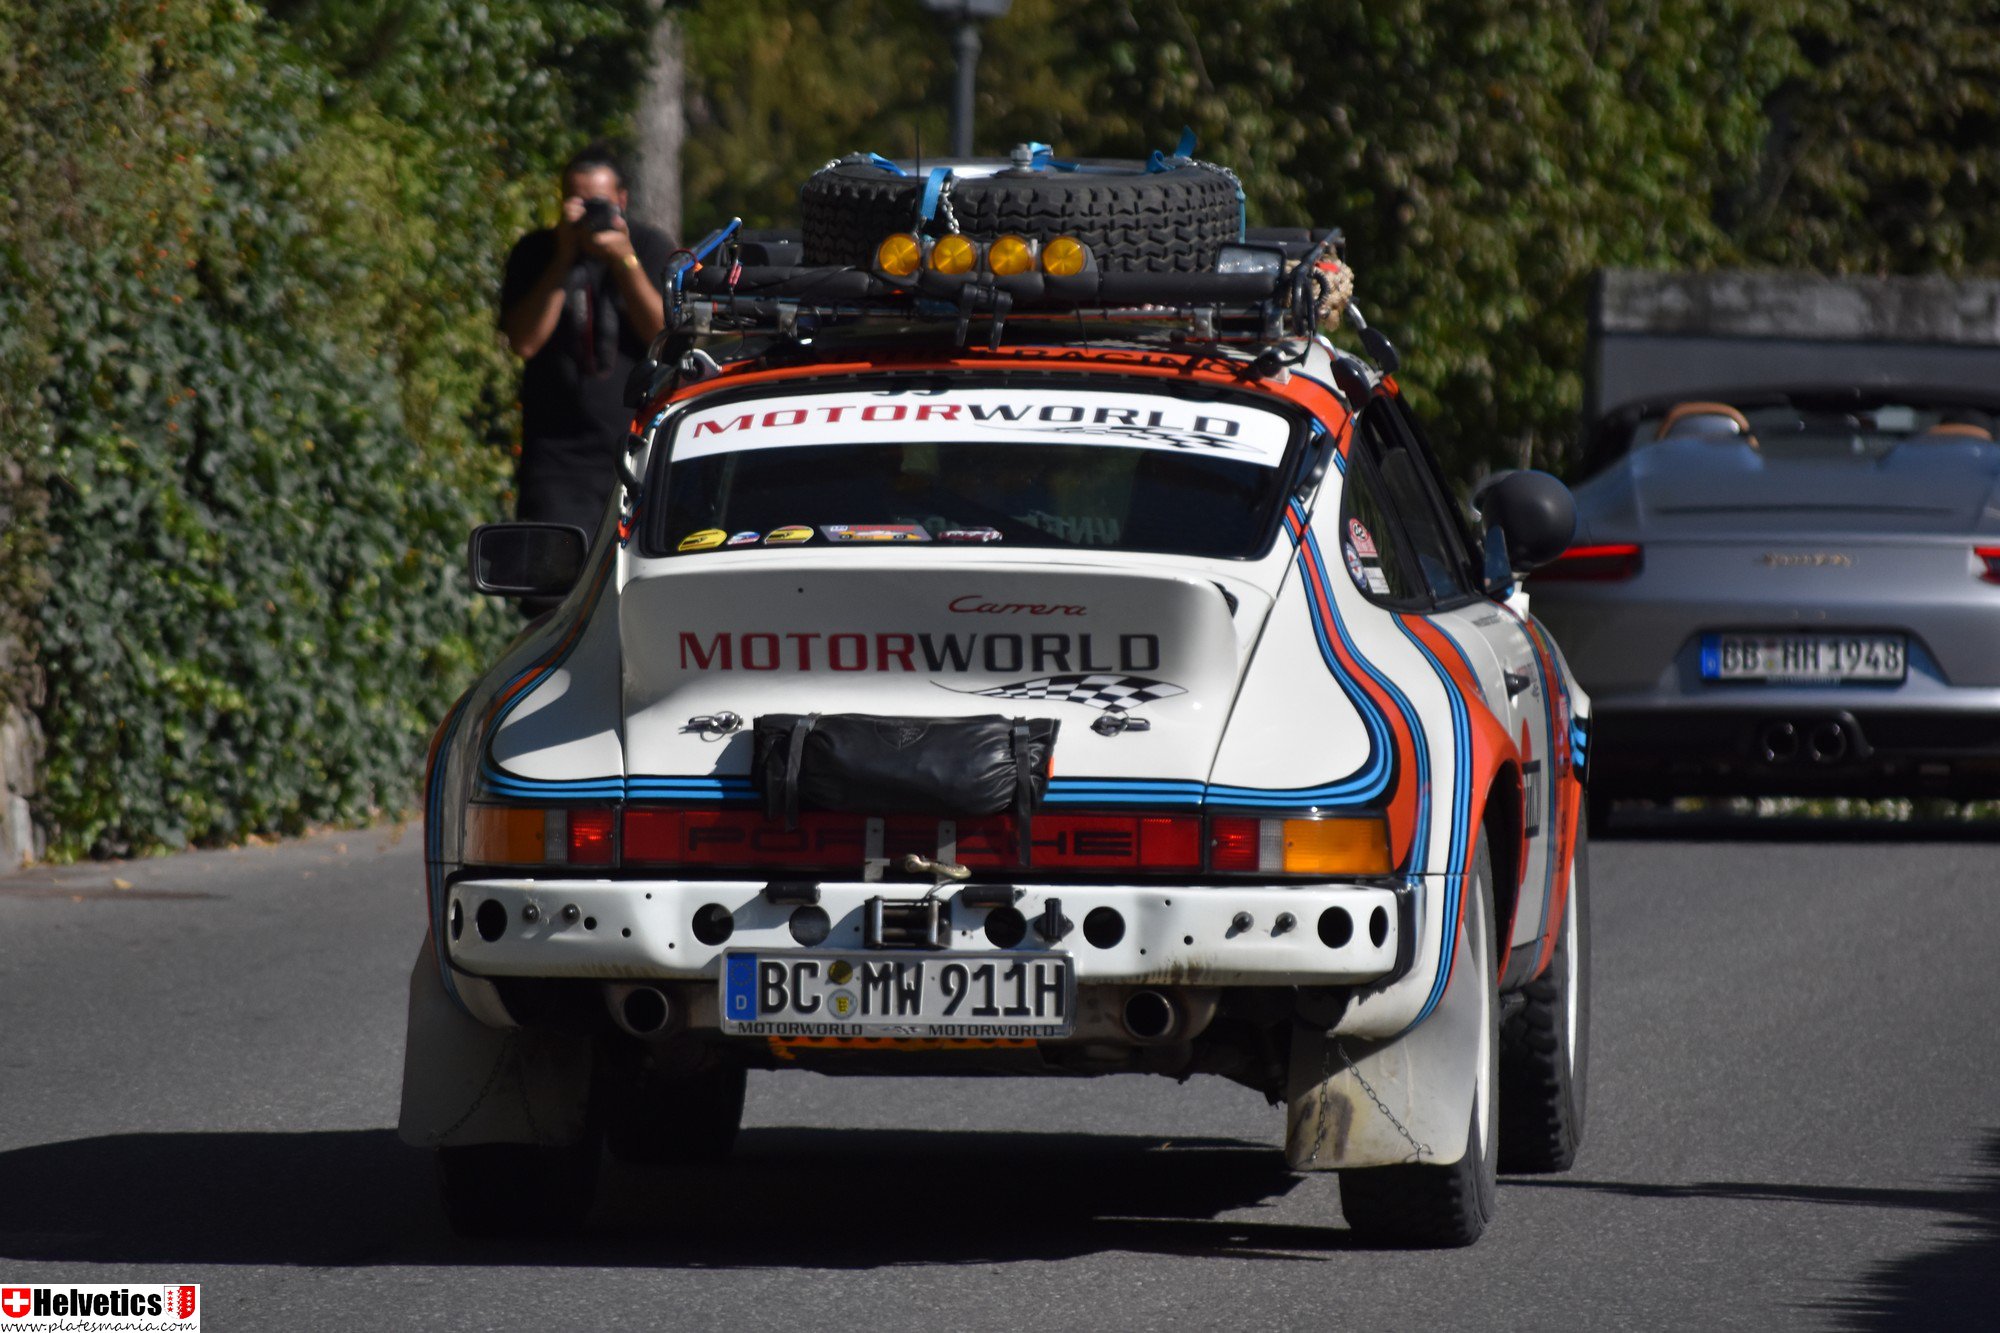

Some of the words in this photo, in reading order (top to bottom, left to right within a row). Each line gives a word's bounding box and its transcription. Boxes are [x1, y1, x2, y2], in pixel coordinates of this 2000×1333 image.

[693, 403, 1240, 439] MOTORWORLD
[948, 594, 1088, 616] Carrera
[678, 632, 1160, 672] MOTORWORLD
[1828, 640, 1899, 671] 1948
[736, 994, 748, 1010] D
[760, 961, 822, 1014] BC
[861, 961, 925, 1015] MW
[940, 963, 1066, 1017] 911H
[738, 1022, 863, 1036] MOTORWORLD
[928, 1024, 1055, 1037] MOTORWORLD
